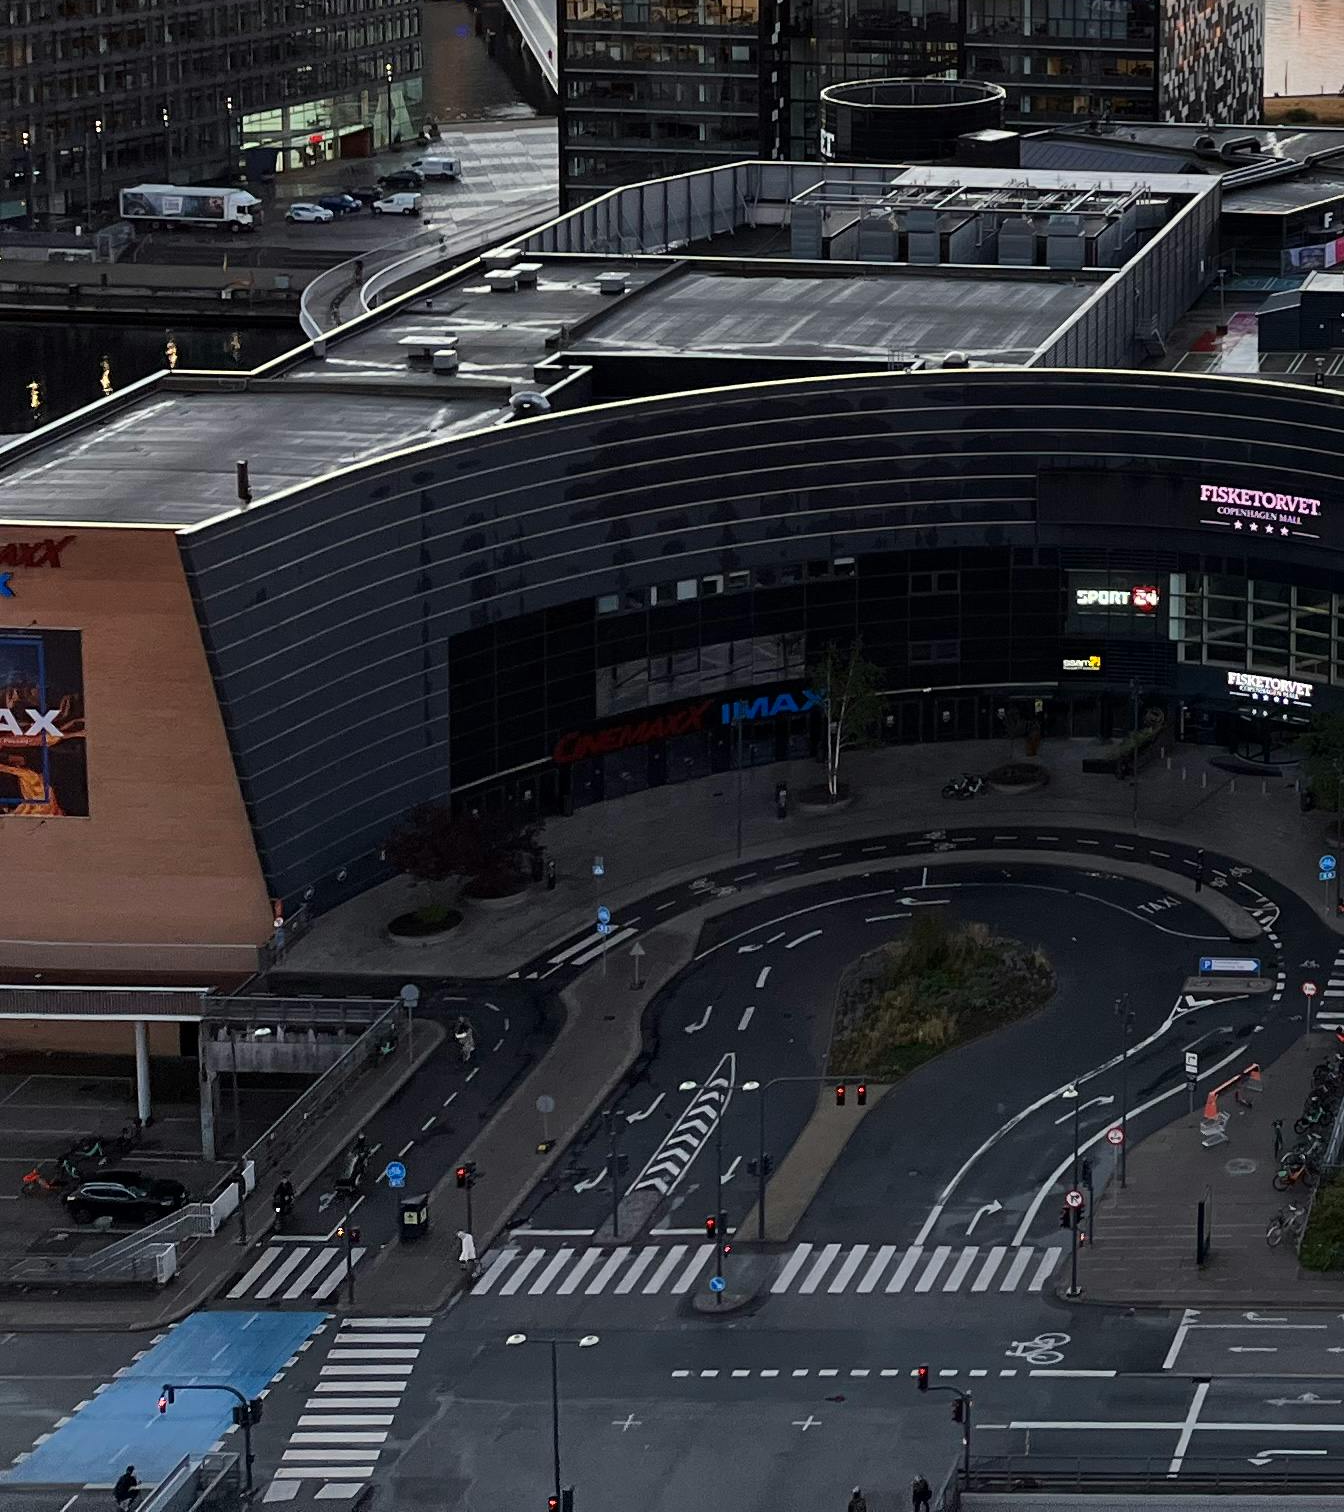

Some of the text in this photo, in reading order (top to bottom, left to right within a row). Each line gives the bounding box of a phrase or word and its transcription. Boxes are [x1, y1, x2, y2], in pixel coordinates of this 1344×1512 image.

[1200, 484, 1321, 516] FISKETORVET
[1217, 506, 1278, 521] COPENHAGEN
[1076, 588, 1160, 606] SPORT 24
[1227, 671, 1313, 697] FISKETORVET
[552, 688, 829, 765] CINEMAXX IMAX
[1136, 895, 1183, 914] TAXI
